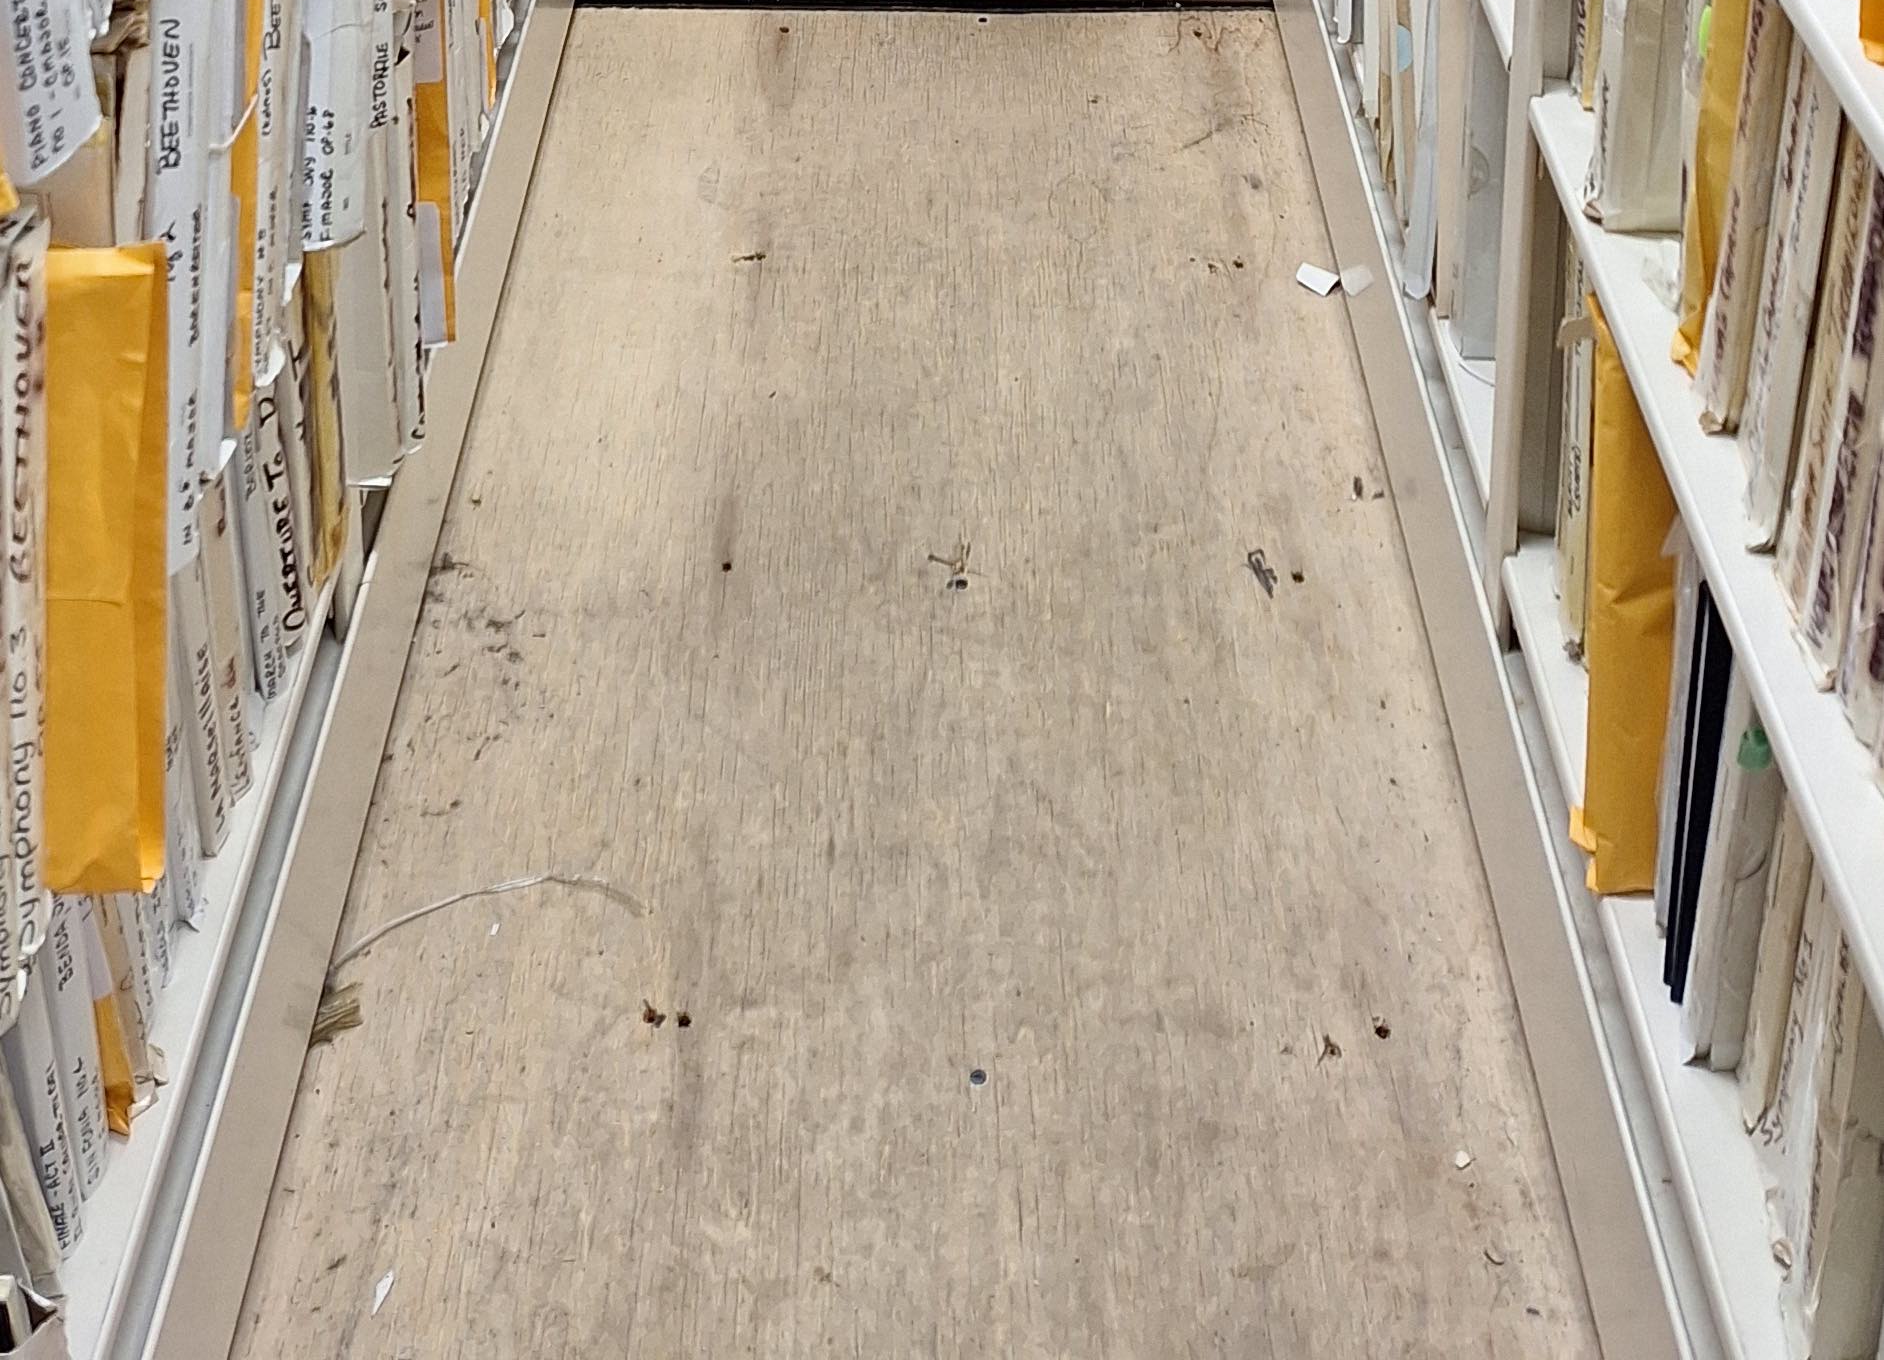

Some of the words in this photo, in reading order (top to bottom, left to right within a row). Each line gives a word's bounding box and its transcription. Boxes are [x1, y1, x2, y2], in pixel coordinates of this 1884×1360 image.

[26, 104, 48, 169] PIANO
[158, 17, 183, 169] BEETHOVEN
[271, 496, 307, 633] OVERTURE
[8, 624, 28, 651] 3
[12, 739, 42, 940] Symphony
